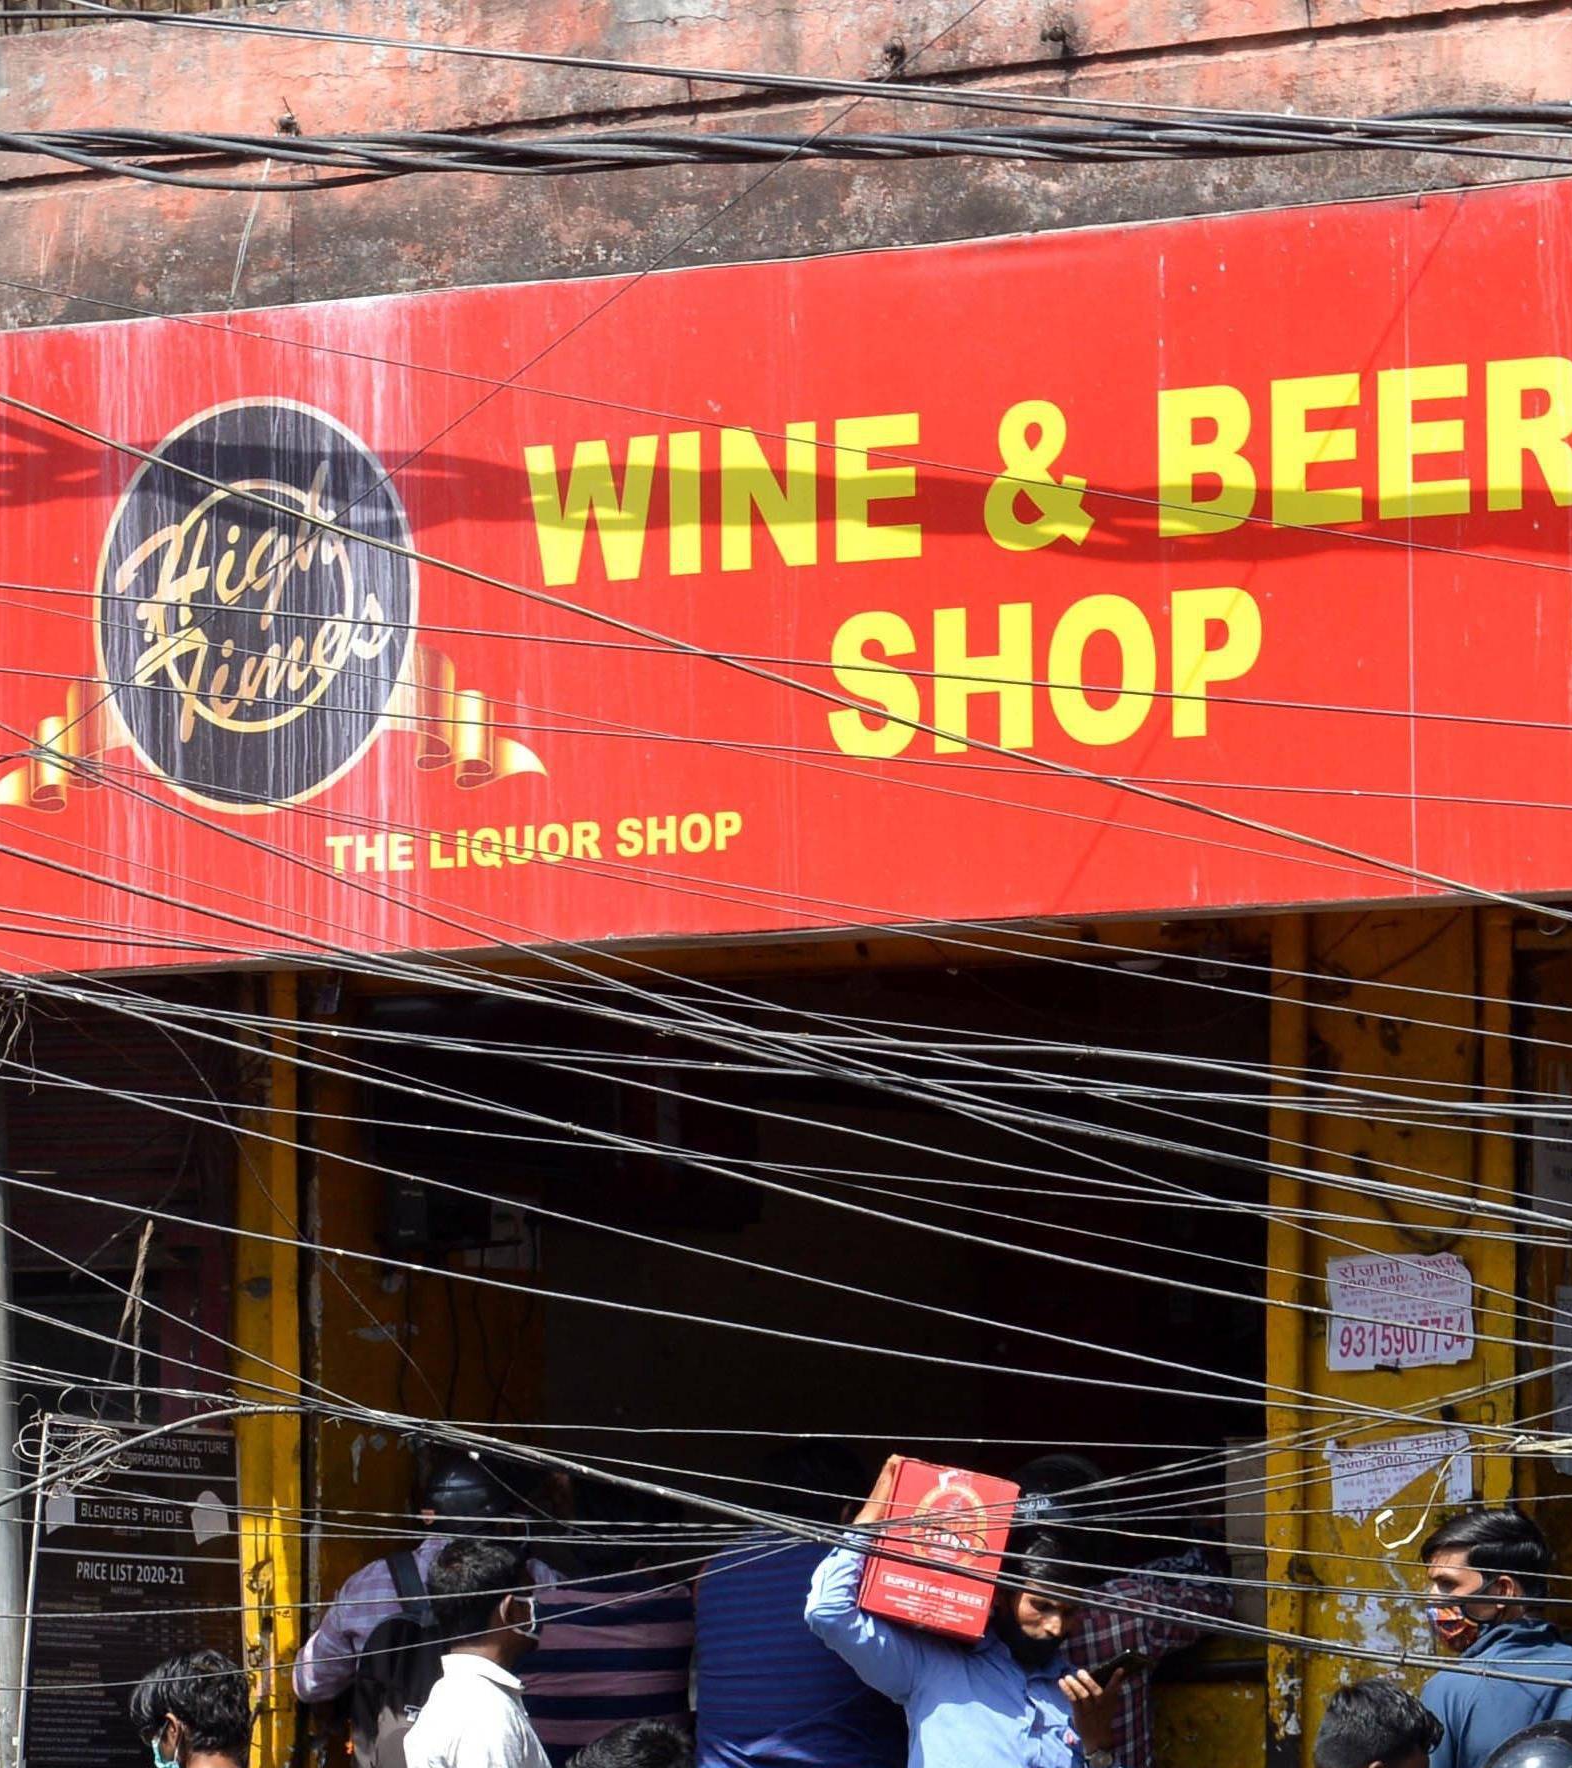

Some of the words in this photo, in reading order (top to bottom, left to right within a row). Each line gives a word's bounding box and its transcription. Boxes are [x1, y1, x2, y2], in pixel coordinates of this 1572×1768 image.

[522, 410, 924, 587] WINE
[981, 398, 1097, 552] &
[114, 458, 349, 652] High
[826, 585, 1262, 761] SHOP
[325, 832, 415, 876] THE
[429, 819, 602, 870] LIQUOR
[615, 809, 744, 855] SHOP
[1338, 1313, 1468, 1359] 9315907754
[80, 1502, 139, 1522] BLENDERS
[142, 1508, 185, 1525] PRIDE
[76, 1560, 109, 1581] PRICE
[109, 1563, 134, 1582] LIST
[135, 1564, 185, 1585] 2020-21
